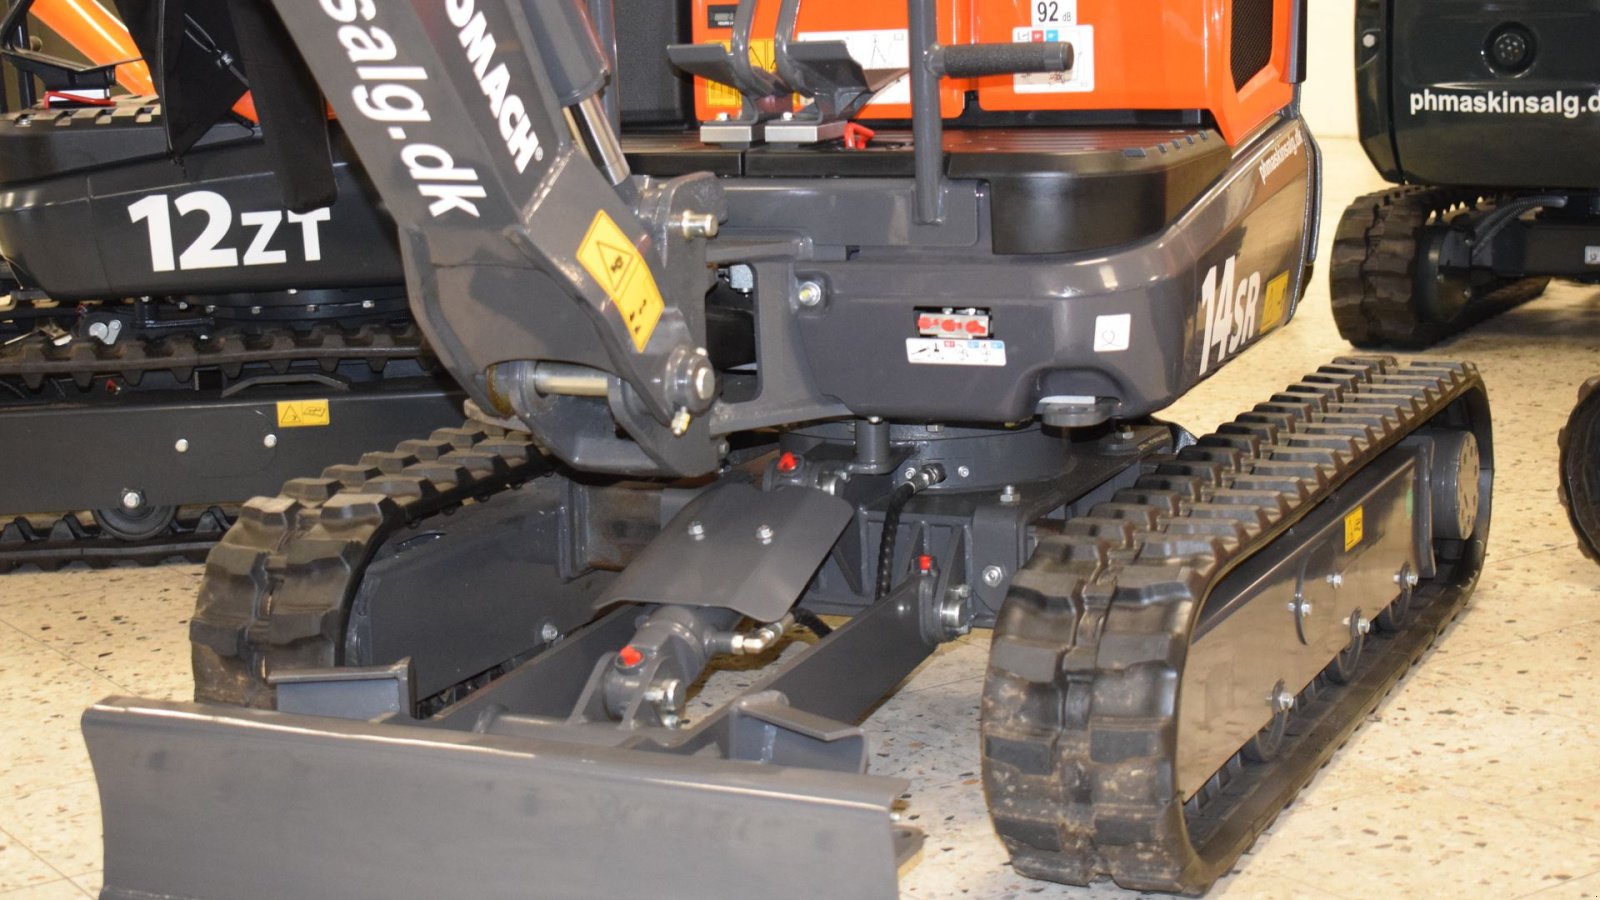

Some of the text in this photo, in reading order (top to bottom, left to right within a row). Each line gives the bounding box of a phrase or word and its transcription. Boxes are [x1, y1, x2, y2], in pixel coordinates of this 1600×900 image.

[1037, 1, 1059, 22] 92
[127, 190, 331, 272] 12ZT
[1198, 255, 1261, 377] 14SR
